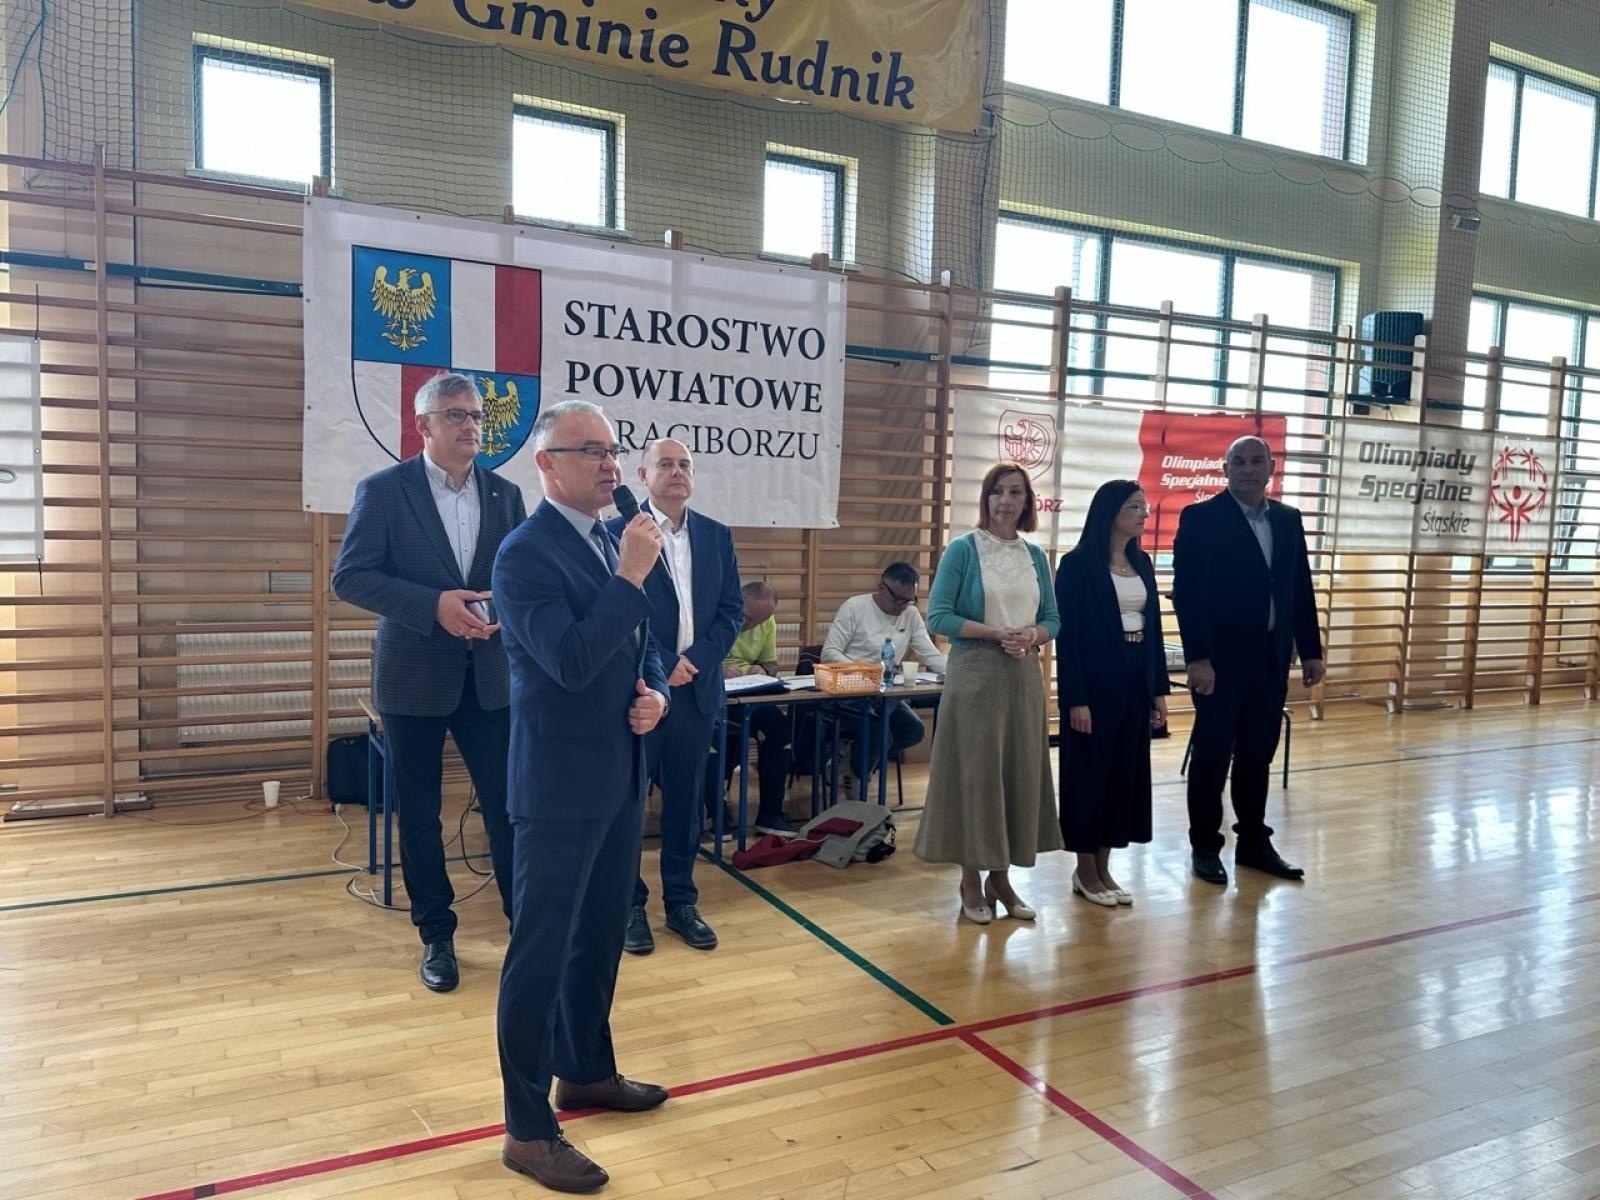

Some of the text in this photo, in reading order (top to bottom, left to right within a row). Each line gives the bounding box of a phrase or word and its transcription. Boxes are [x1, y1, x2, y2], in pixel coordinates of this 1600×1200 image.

[712, 19, 915, 110] Rudnik
[564, 300, 825, 361] STAROSTWO
[565, 360, 823, 413] POWIATOWE
[1359, 440, 1477, 476] Olimpiady
[1160, 473, 1230, 489] Specjalne
[1358, 474, 1473, 505] Specjalne
[1420, 506, 1471, 537] Śląskie
